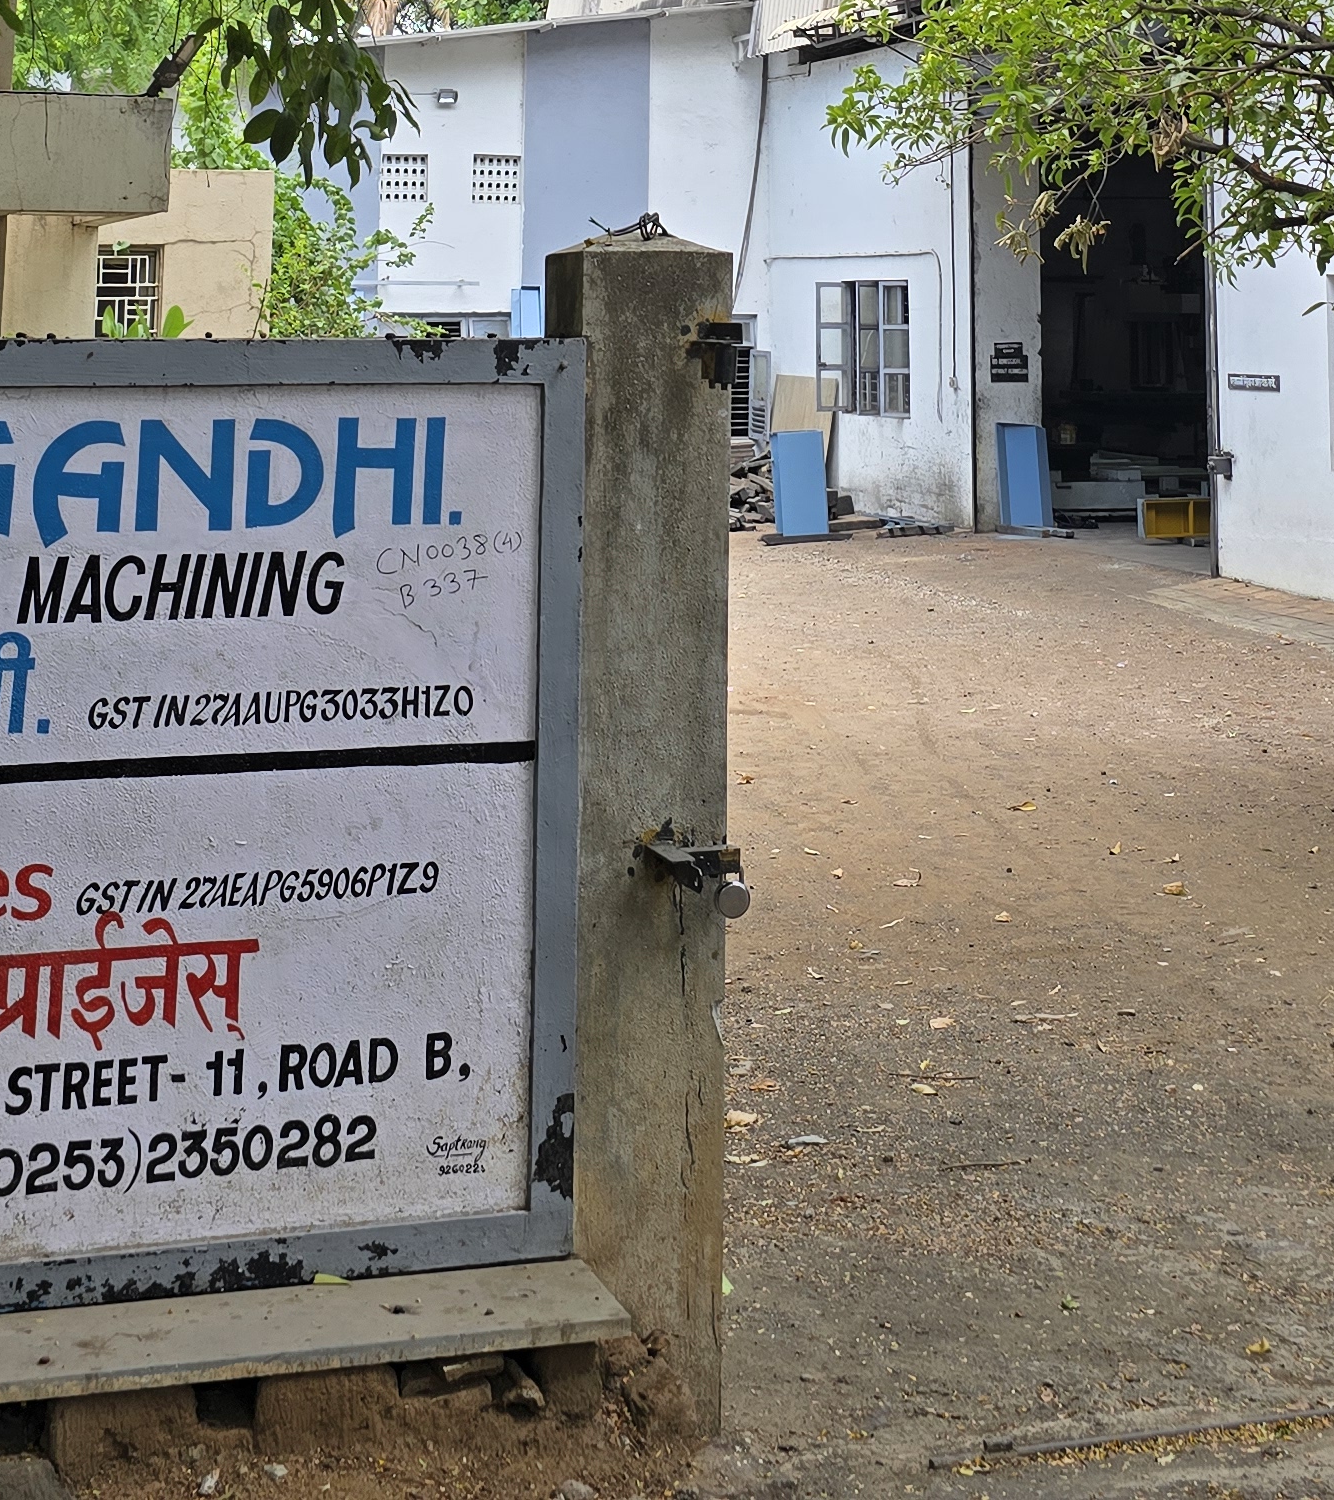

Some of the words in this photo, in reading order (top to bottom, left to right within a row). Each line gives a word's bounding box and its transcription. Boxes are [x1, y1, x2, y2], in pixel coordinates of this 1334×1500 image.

[16, 550, 345, 625] MACHINING
[278, 1037, 399, 1093] ROAD
[425, 1031, 471, 1082] B,
